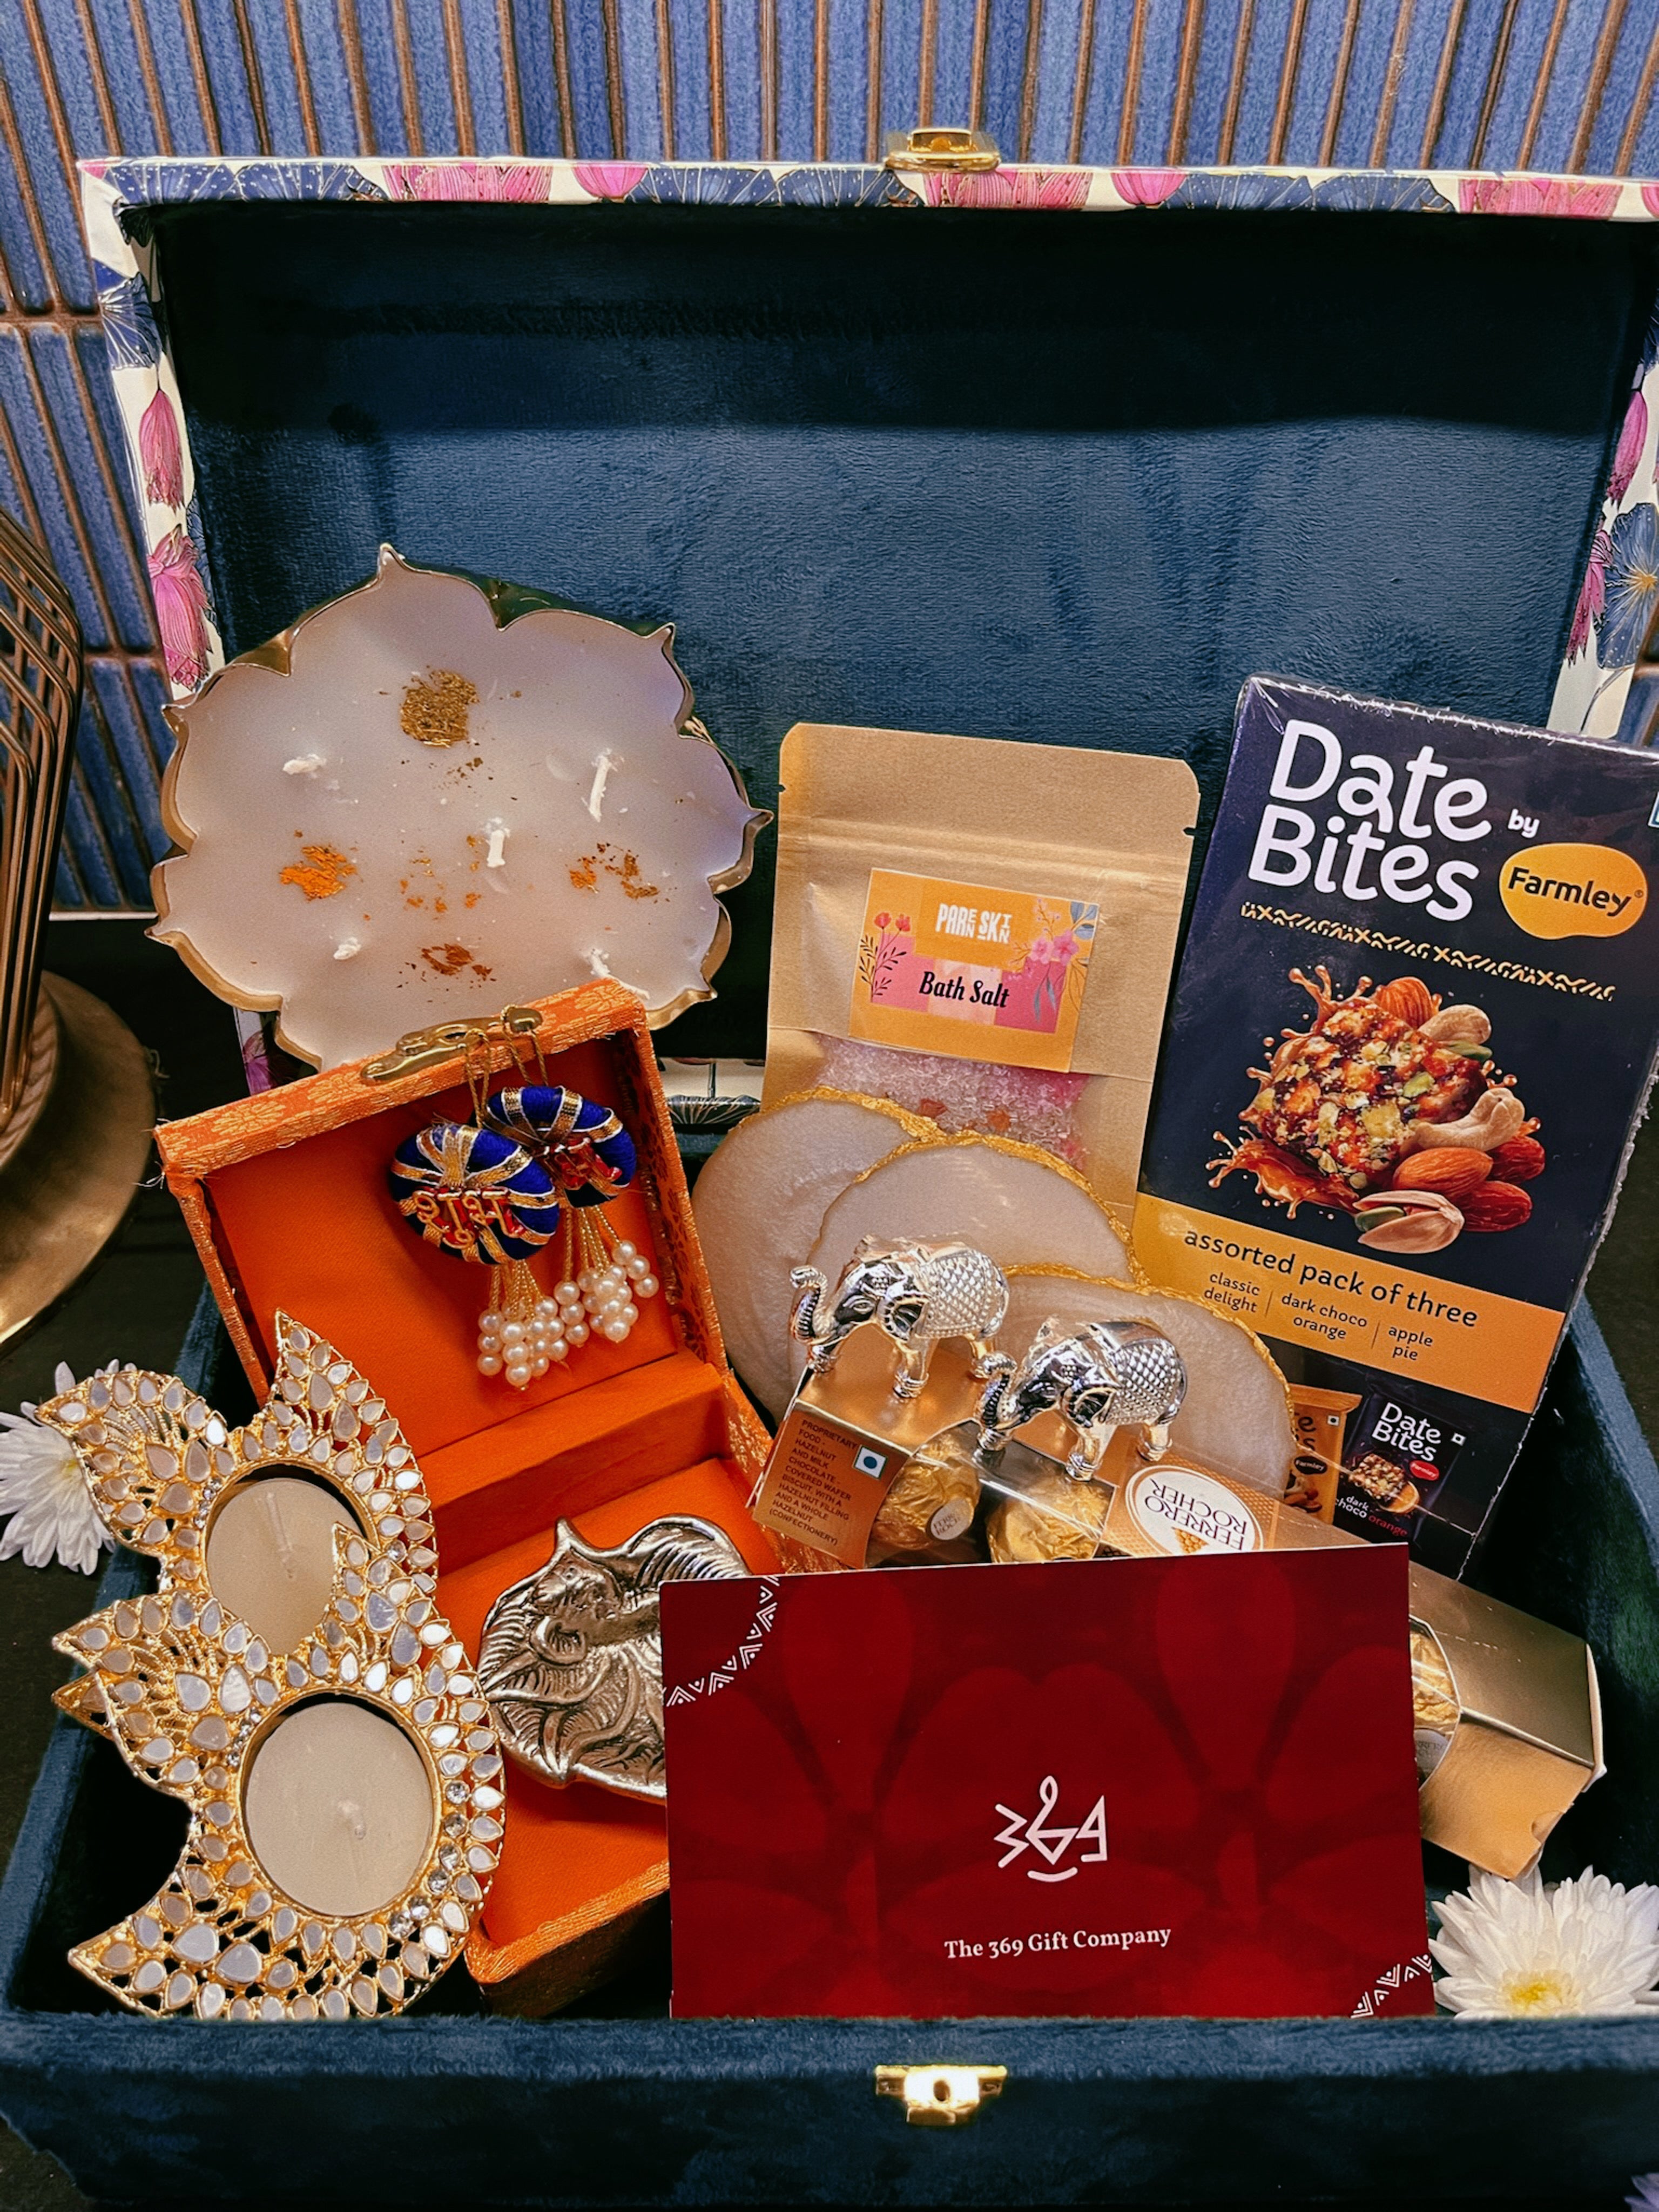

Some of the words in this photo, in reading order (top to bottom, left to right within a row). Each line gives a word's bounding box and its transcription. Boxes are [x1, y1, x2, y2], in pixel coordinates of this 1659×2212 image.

[1269, 719, 1492, 842] Date
[1507, 808, 1540, 839] by
[1247, 804, 1480, 922] Bites
[1507, 867, 1631, 917] Farmley
[919, 972, 965, 1000] Bath
[969, 980, 1010, 1008] Salt
[1184, 1228, 1296, 1274] assorted
[1299, 1262, 1363, 1296] pack
[1371, 1280, 1403, 1304] of
[1407, 1291, 1478, 1327] three
[1209, 1271, 1260, 1297] classic
[1204, 1287, 1258, 1313] delight
[1282, 1293, 1316, 1313] dark
[1319, 1304, 1367, 1328] choco
[1293, 1316, 1346, 1340] orange
[1388, 1323, 1433, 1347] apple
[1392, 1344, 1418, 1361] pie
[799, 1429, 821, 1444] FOOD
[802, 1420, 858, 1449] PROPRIETARY
[1380, 1402, 1441, 1445] Date
[795, 1438, 836, 1461] HAZELNUT
[1372, 1420, 1437, 1461] Bites
[789, 1456, 836, 1483] CHOCOLATE
[792, 1448, 808, 1458] AND
[811, 1455, 830, 1469] MILK
[786, 1465, 822, 1486] COVERED
[824, 1483, 852, 1501] WAFER
[815, 1489, 835, 1503] WITH
[772, 1500, 814, 1522] HAZELNUT
[775, 1492, 792, 1503] AND
[801, 1502, 829, 1520] WHOLE
[779, 1482, 819, 1505] HAZELNUT
[820, 1502, 849, 1520] FILLING
[1150, 1479, 1246, 1534] ROCHER
[1346, 1496, 1369, 1511] dark
[769, 1508, 838, 1546] (CONFECTIONERY)
[1145, 1495, 1244, 1550] FERRERO
[1368, 1515, 1407, 1536] orange
[944, 1939, 983, 1958] The
[989, 1937, 1023, 1958] 369
[1028, 1931, 1068, 1951] Gift
[1073, 1928, 1171, 1951] Company
